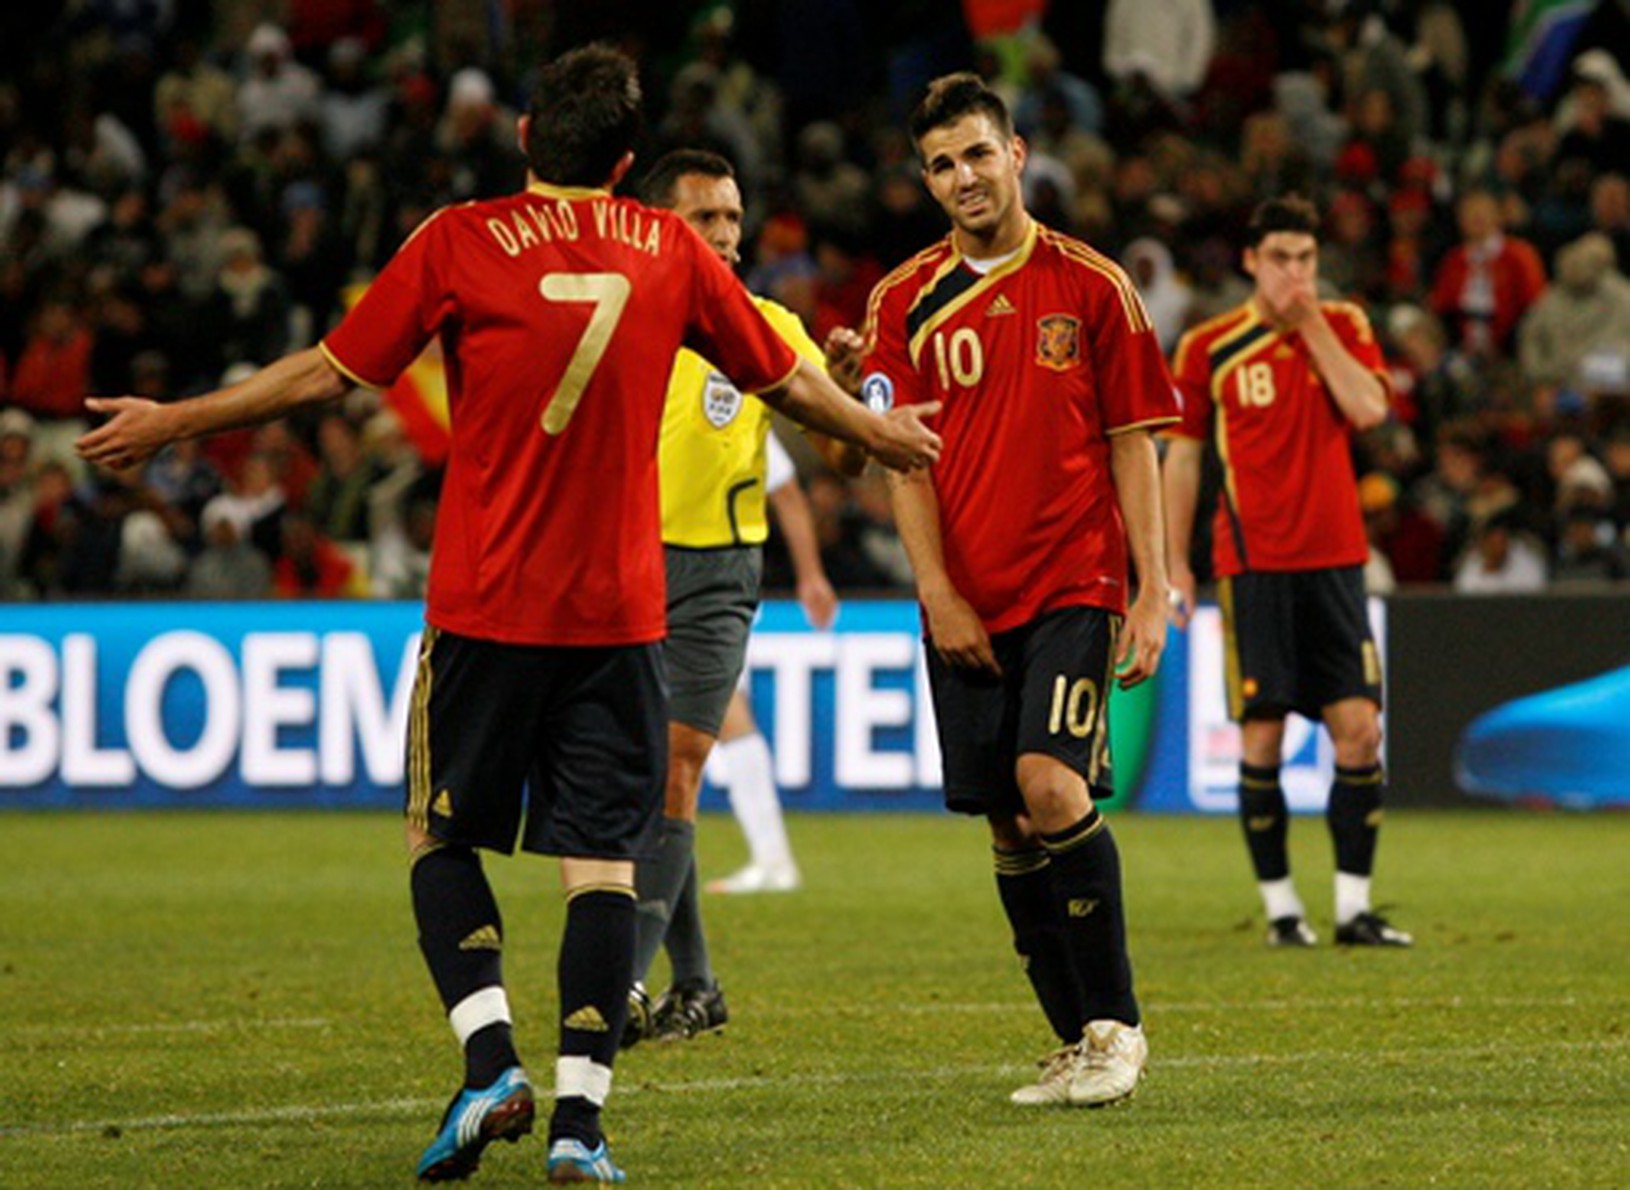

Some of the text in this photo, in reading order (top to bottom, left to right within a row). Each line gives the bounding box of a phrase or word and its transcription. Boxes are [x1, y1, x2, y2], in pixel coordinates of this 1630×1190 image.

[487, 199, 660, 257] DAVID VILLA
[538, 272, 632, 436] 7
[933, 326, 984, 391] 10
[1235, 362, 1277, 408] 18
[1048, 674, 1098, 738] 10
